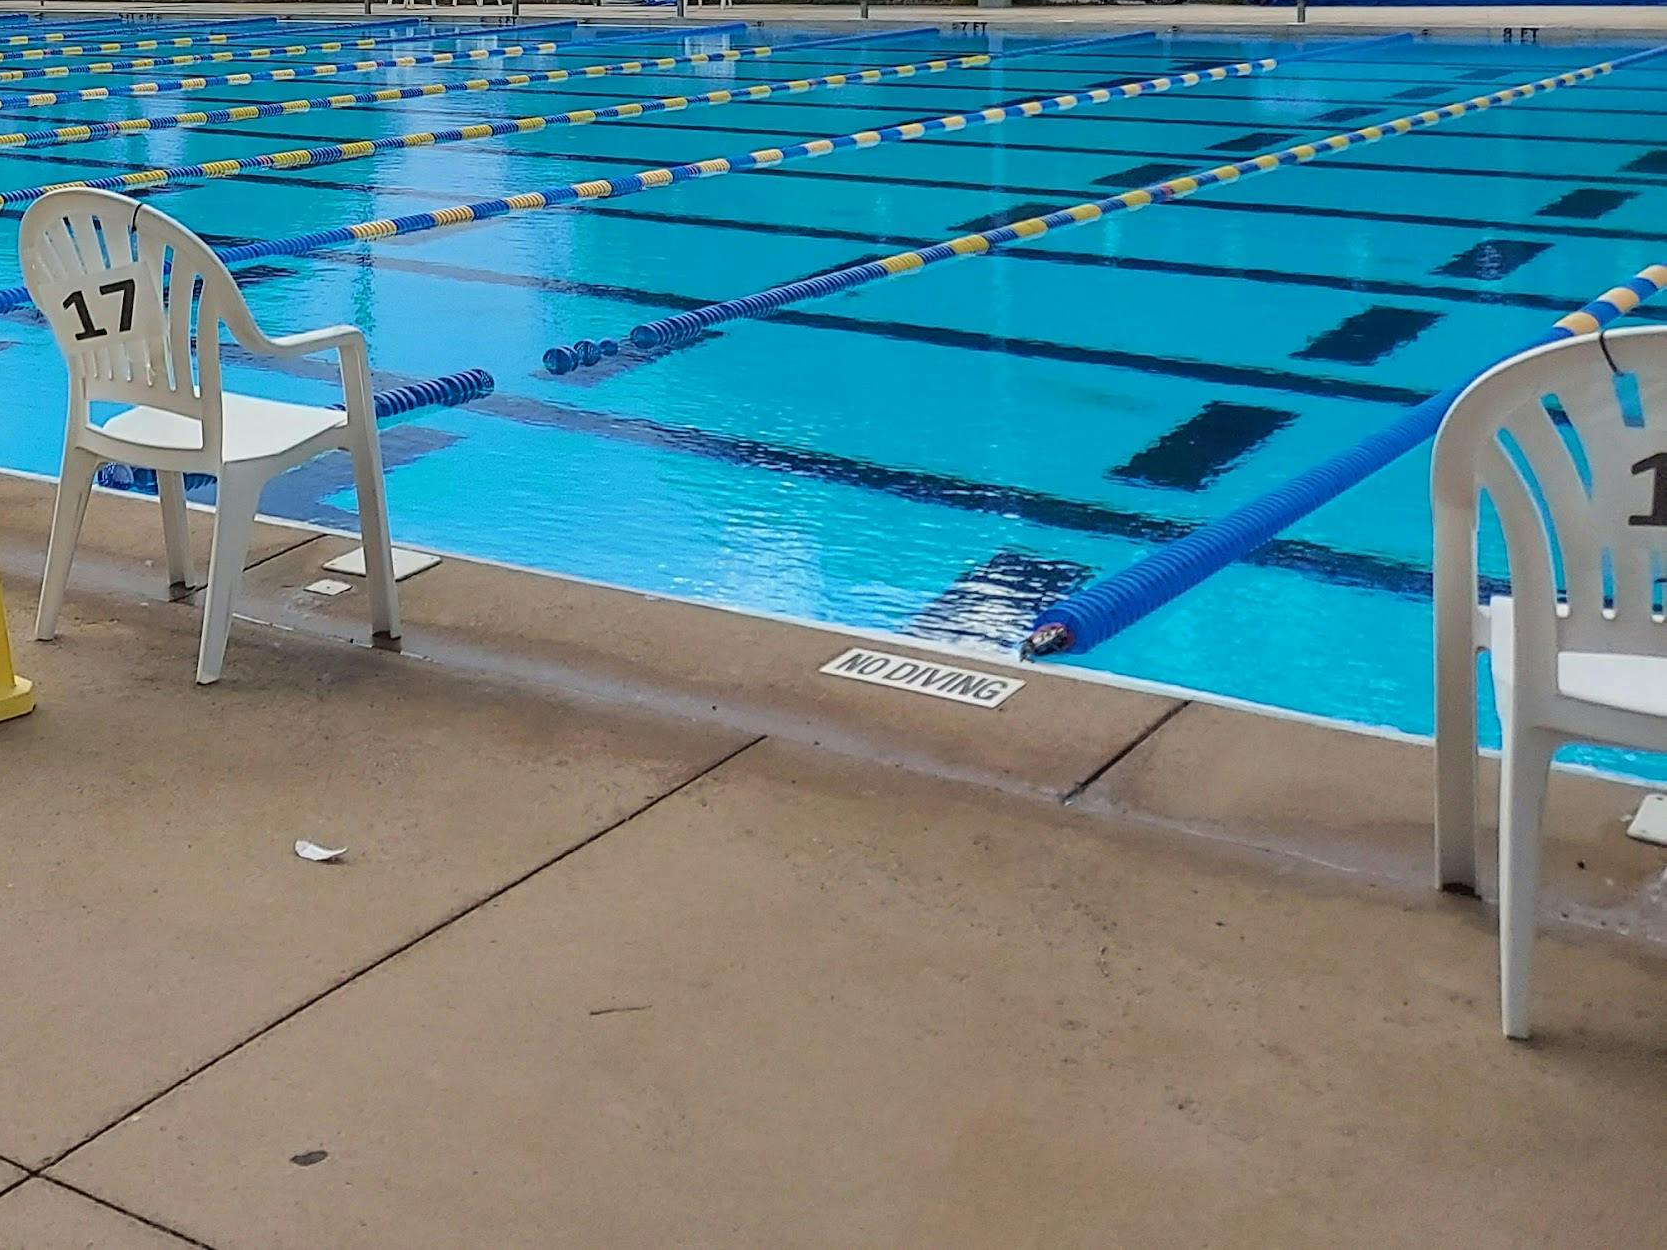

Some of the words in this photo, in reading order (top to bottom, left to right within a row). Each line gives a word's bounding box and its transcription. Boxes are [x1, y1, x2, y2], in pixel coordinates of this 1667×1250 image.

[973, 21, 988, 31] FT
[62, 278, 136, 341] 17
[835, 653, 888, 676] NO
[882, 662, 1009, 701] DIVING
